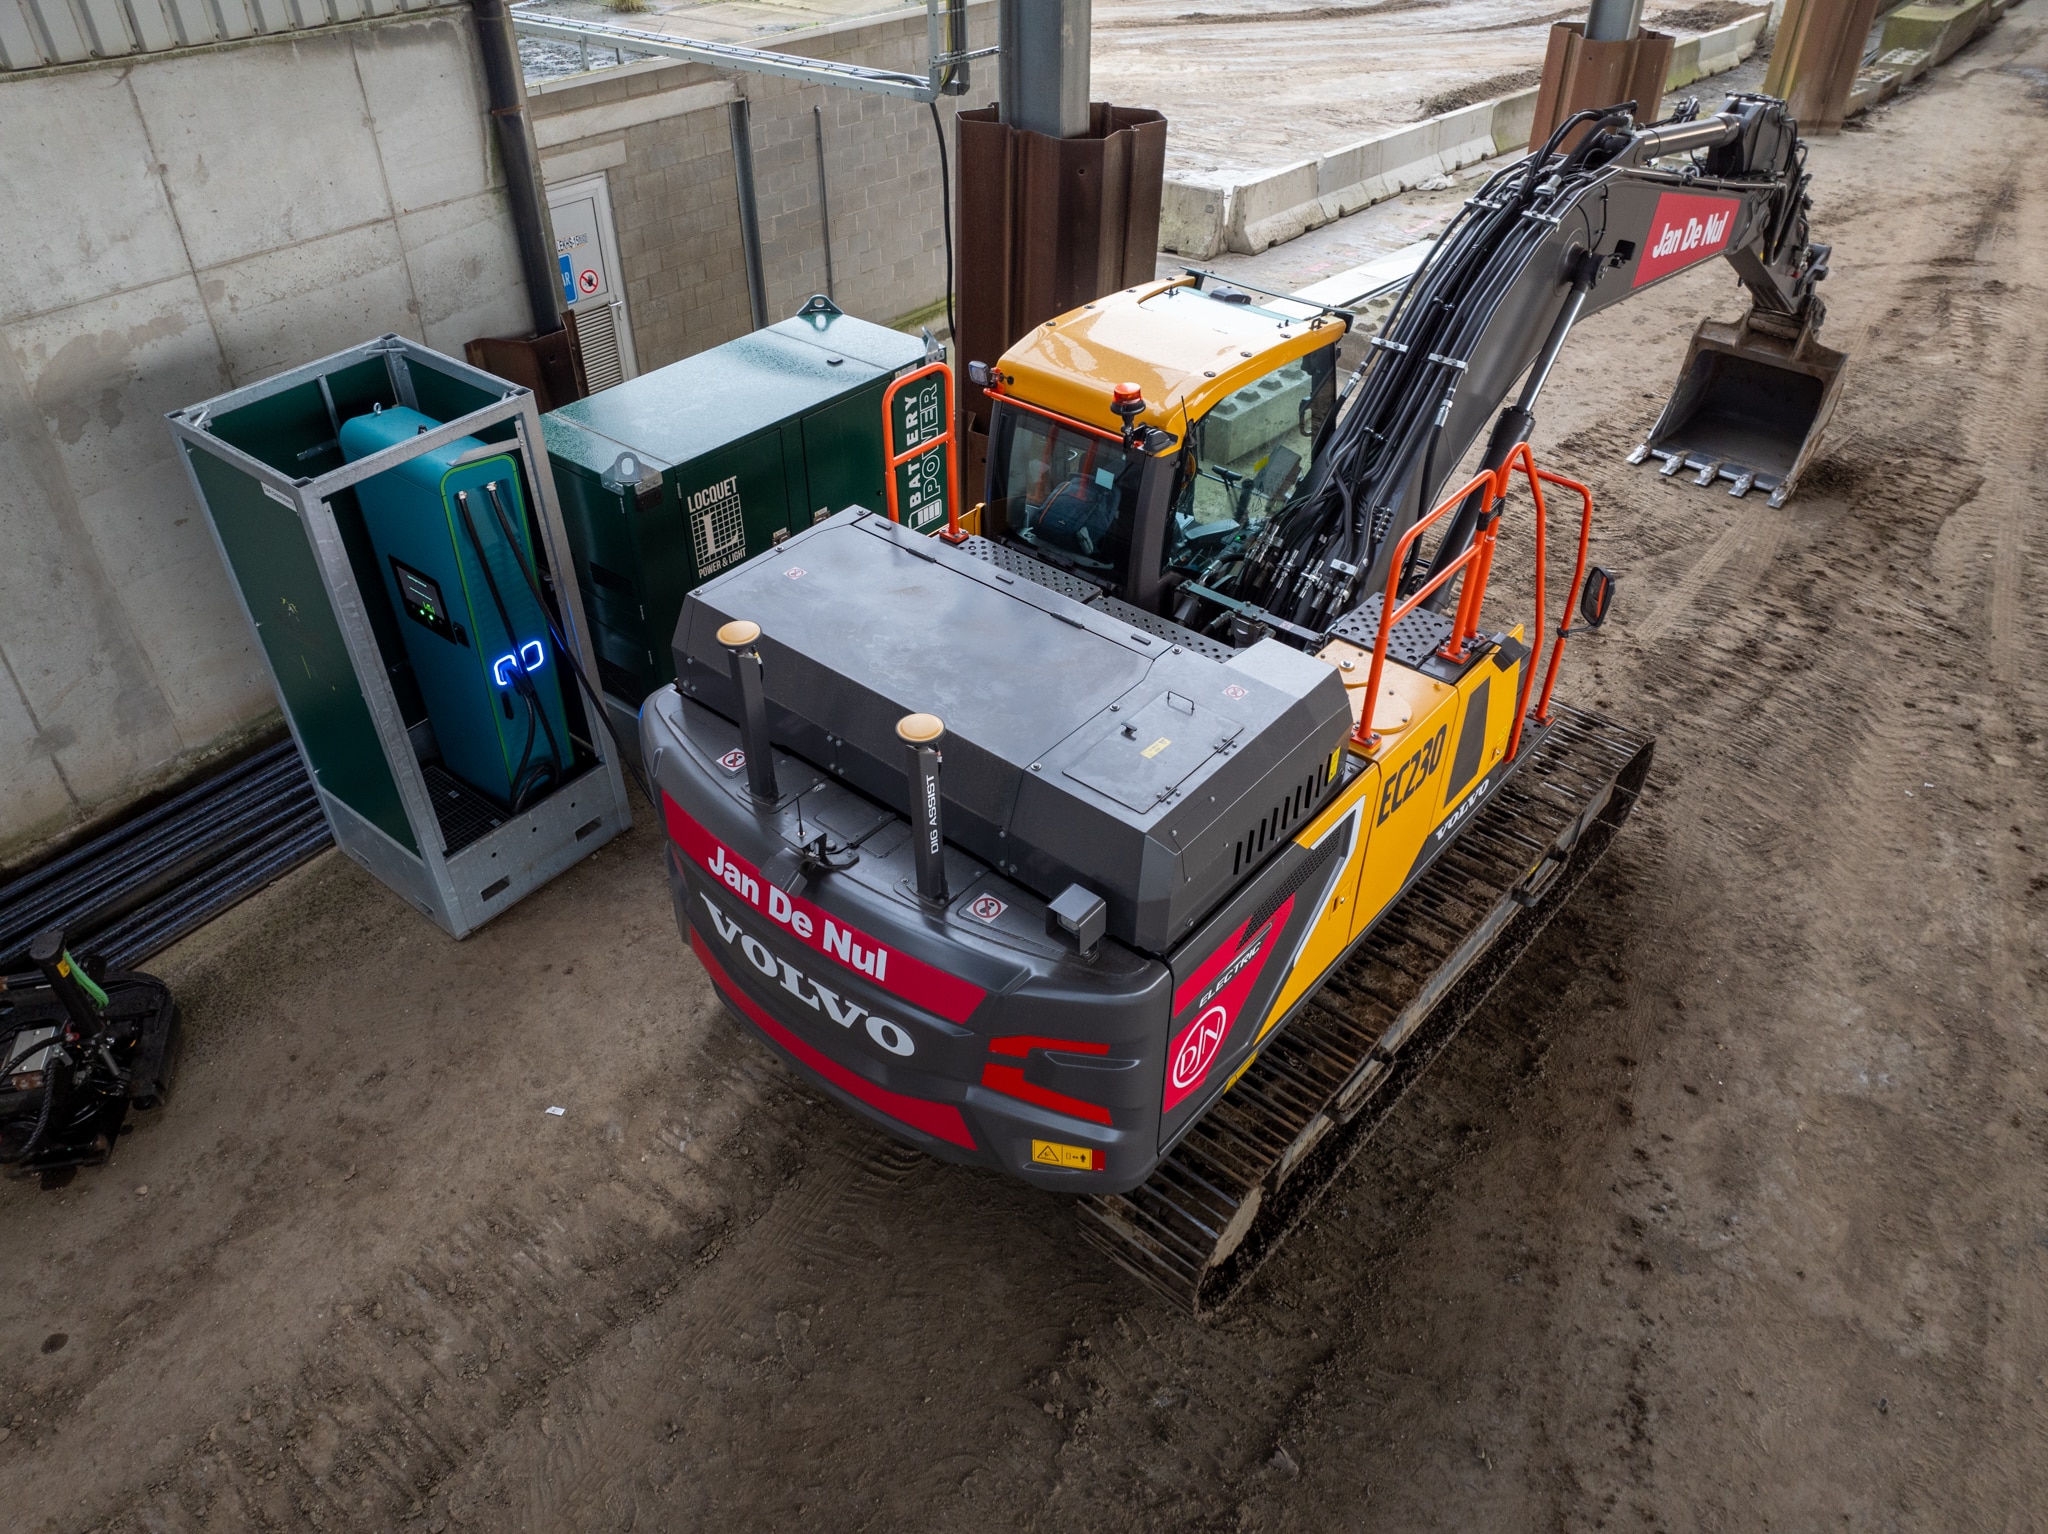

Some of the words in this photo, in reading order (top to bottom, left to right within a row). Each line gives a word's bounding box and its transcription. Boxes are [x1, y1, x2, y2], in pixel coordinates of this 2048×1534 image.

[1652, 222, 1682, 258] Jan
[1680, 217, 1703, 252] De
[1700, 210, 1729, 246] Nul
[904, 396, 922, 508] BATERY
[687, 475, 737, 513] LOCQUET
[698, 560, 722, 579] POWER
[722, 557, 729, 567] &
[728, 547, 746, 565] LIGHT
[926, 774, 938, 826] ASSIST
[1376, 724, 1447, 828] EC230
[1436, 778, 1489, 840] VOLVO
[930, 829, 939, 855] DIG
[707, 846, 759, 906] Jan
[768, 884, 814, 939] De
[822, 919, 888, 982] Nul
[699, 891, 916, 1057] VOLVO
[1199, 941, 1261, 1008] ELECTRIC
